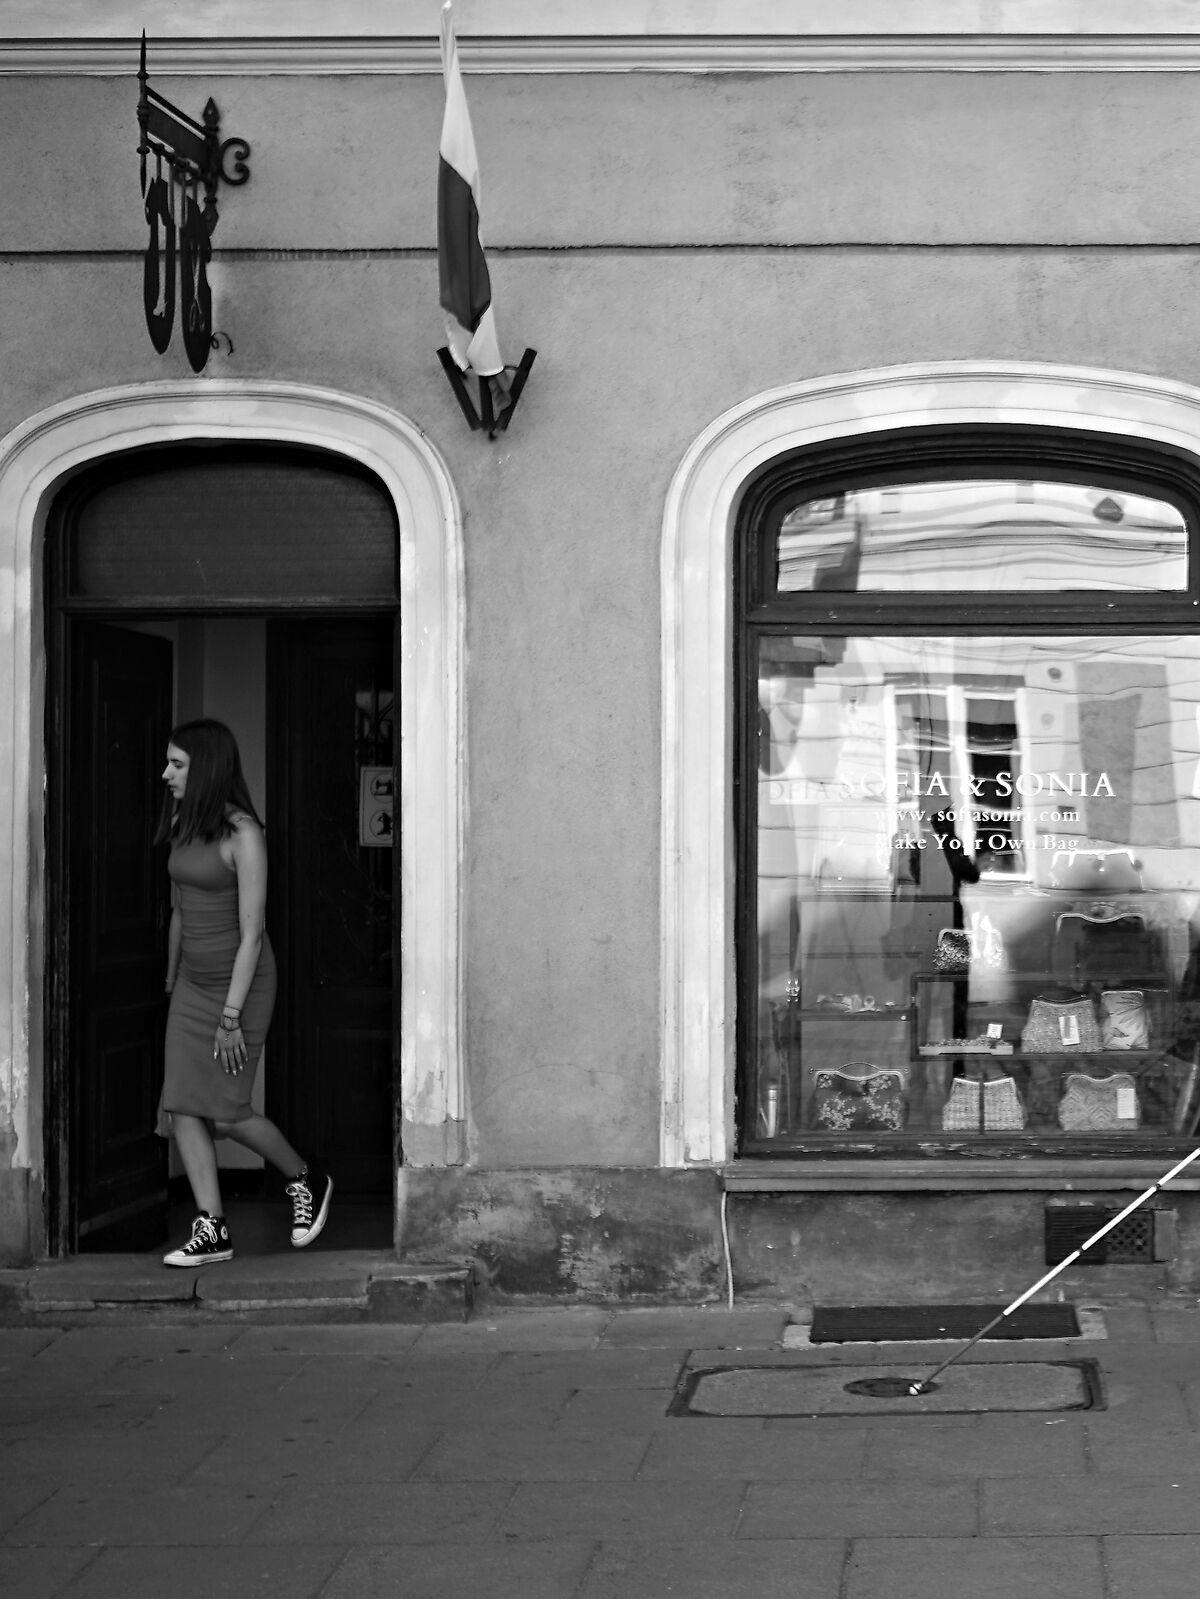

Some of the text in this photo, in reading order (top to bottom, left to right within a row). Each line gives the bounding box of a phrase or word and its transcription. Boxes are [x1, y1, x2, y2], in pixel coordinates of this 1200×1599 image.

[839, 771, 1117, 797] SOFIA & SONIA
[933, 833, 984, 850] Yor
[988, 834, 1037, 850] Own
[1043, 834, 1080, 852] Bag
